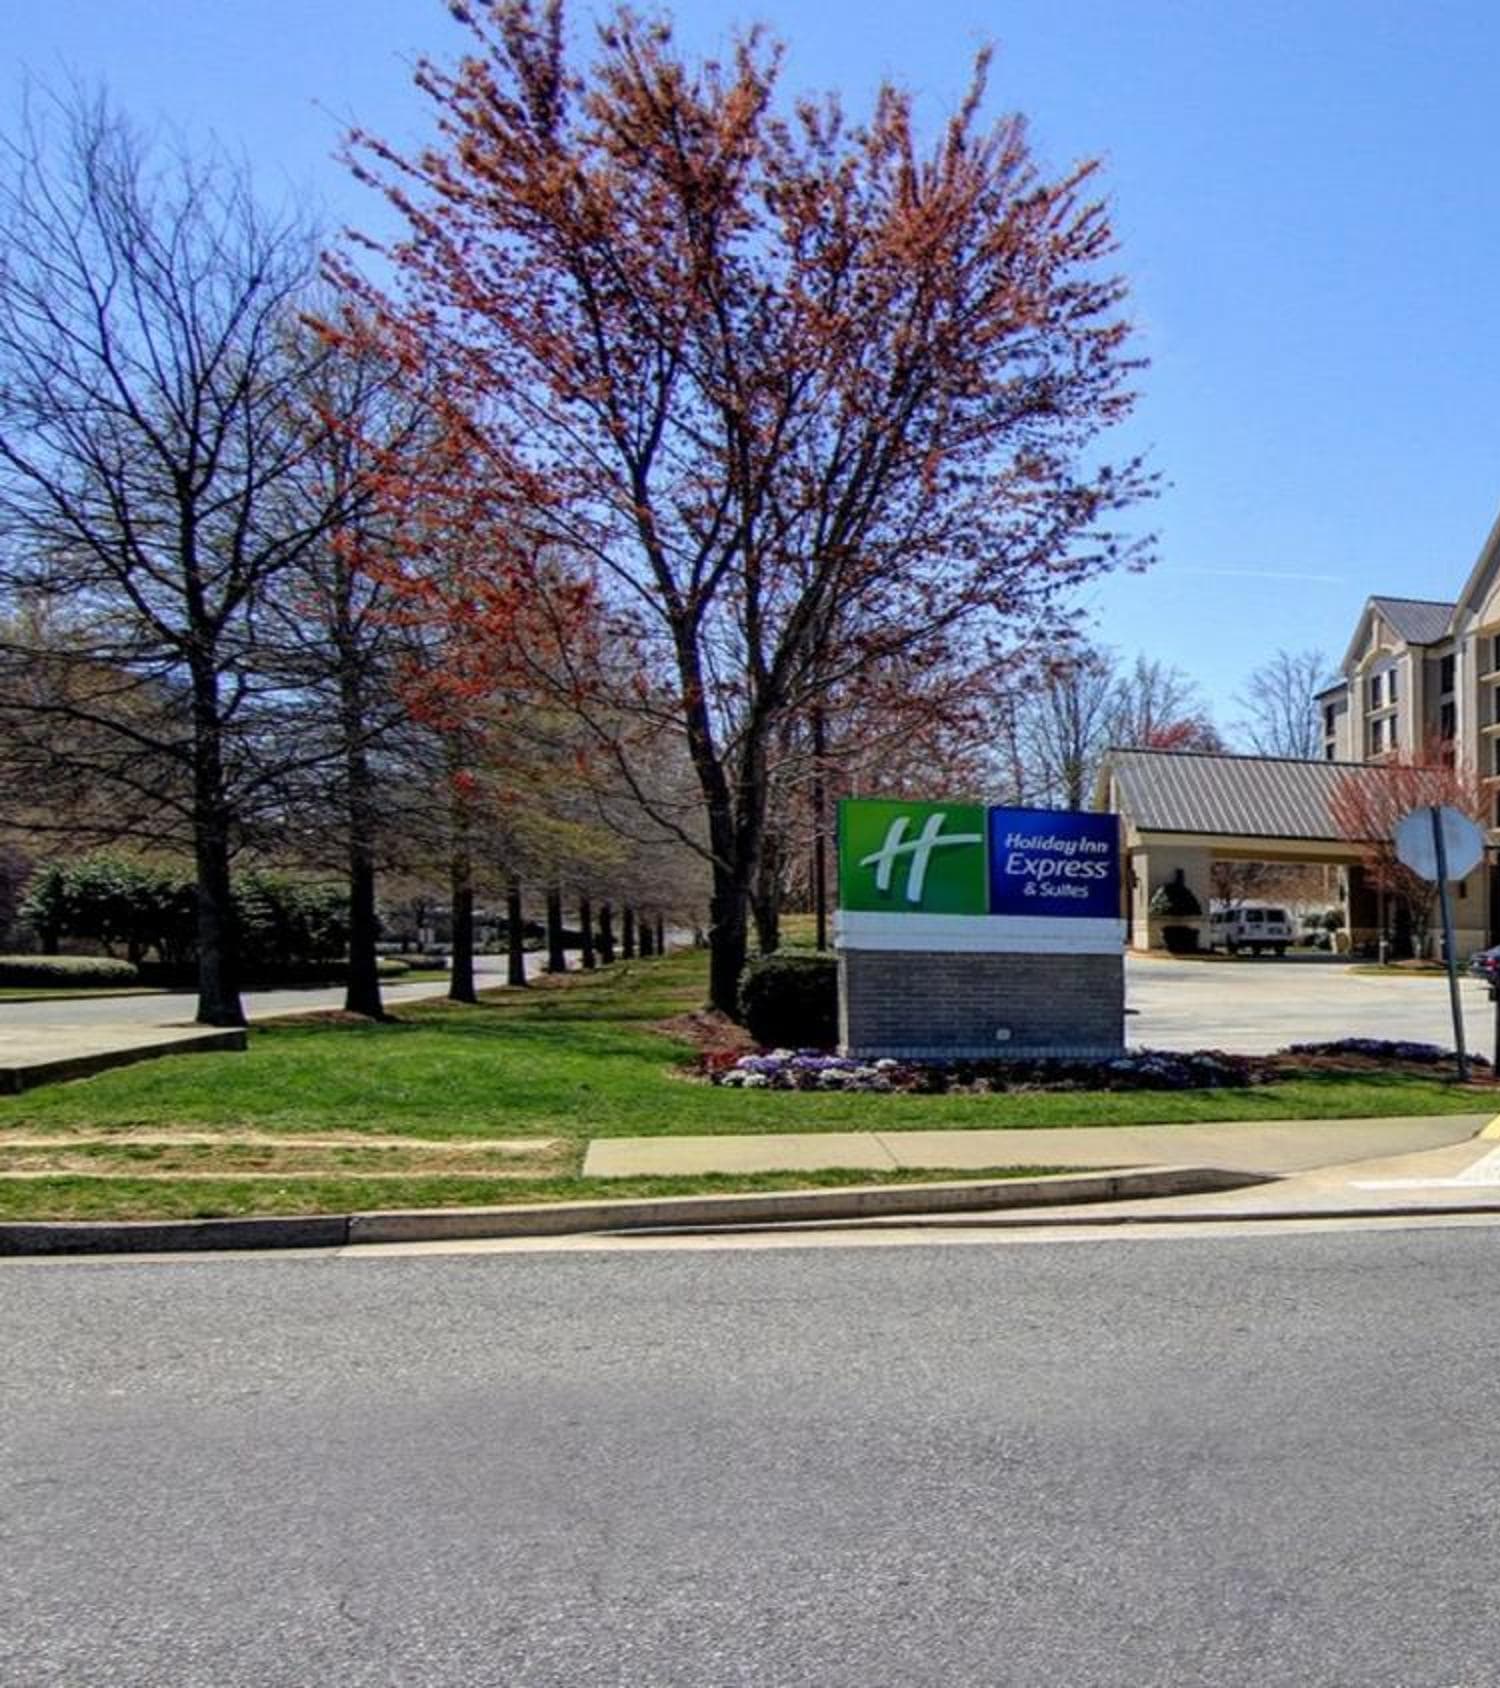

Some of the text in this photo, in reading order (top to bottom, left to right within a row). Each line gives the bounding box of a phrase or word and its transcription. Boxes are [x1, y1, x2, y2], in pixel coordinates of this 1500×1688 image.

[1005, 833, 1109, 856] Holiday Inn
[1005, 852, 1110, 881] Express
[1023, 881, 1089, 898] & Suites
